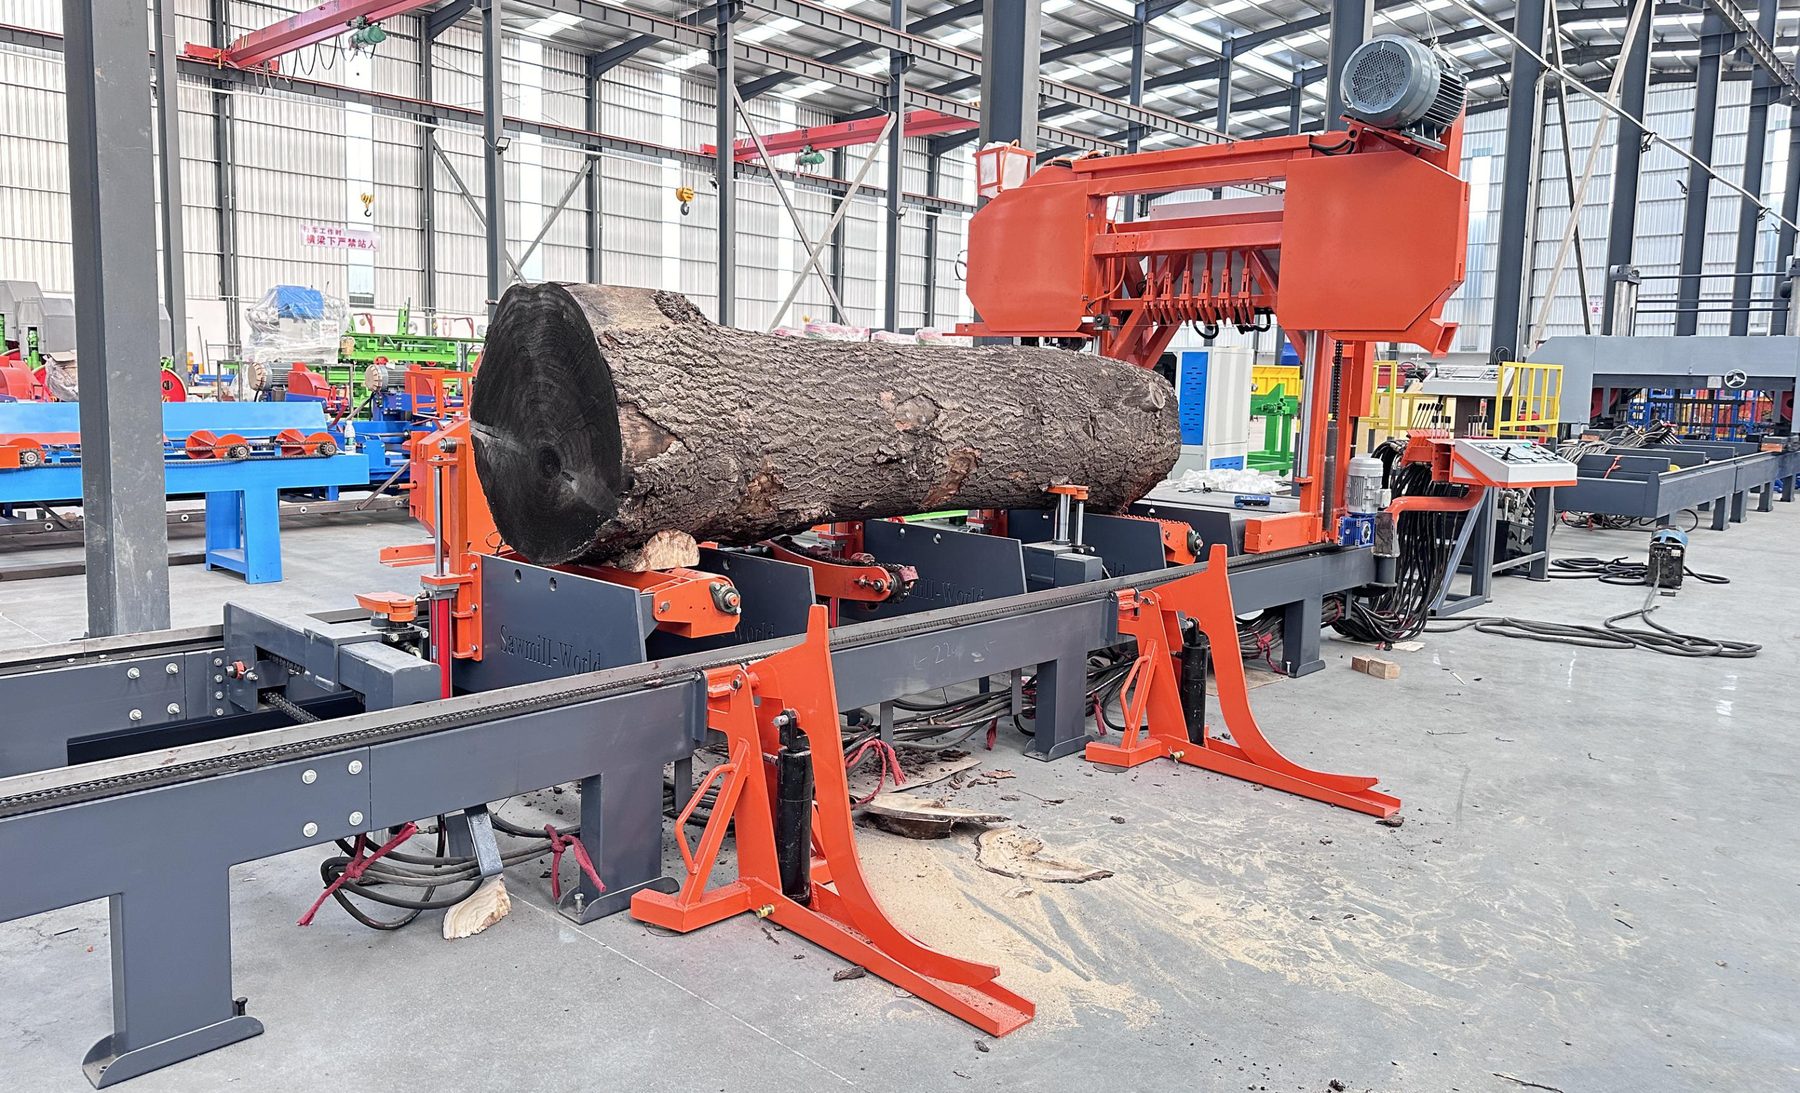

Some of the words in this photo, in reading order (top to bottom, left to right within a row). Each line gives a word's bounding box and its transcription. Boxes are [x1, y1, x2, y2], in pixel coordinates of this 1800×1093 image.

[306, 234, 377, 250] 横梁下严禁站人
[499, 624, 601, 675] Sawmill-World
